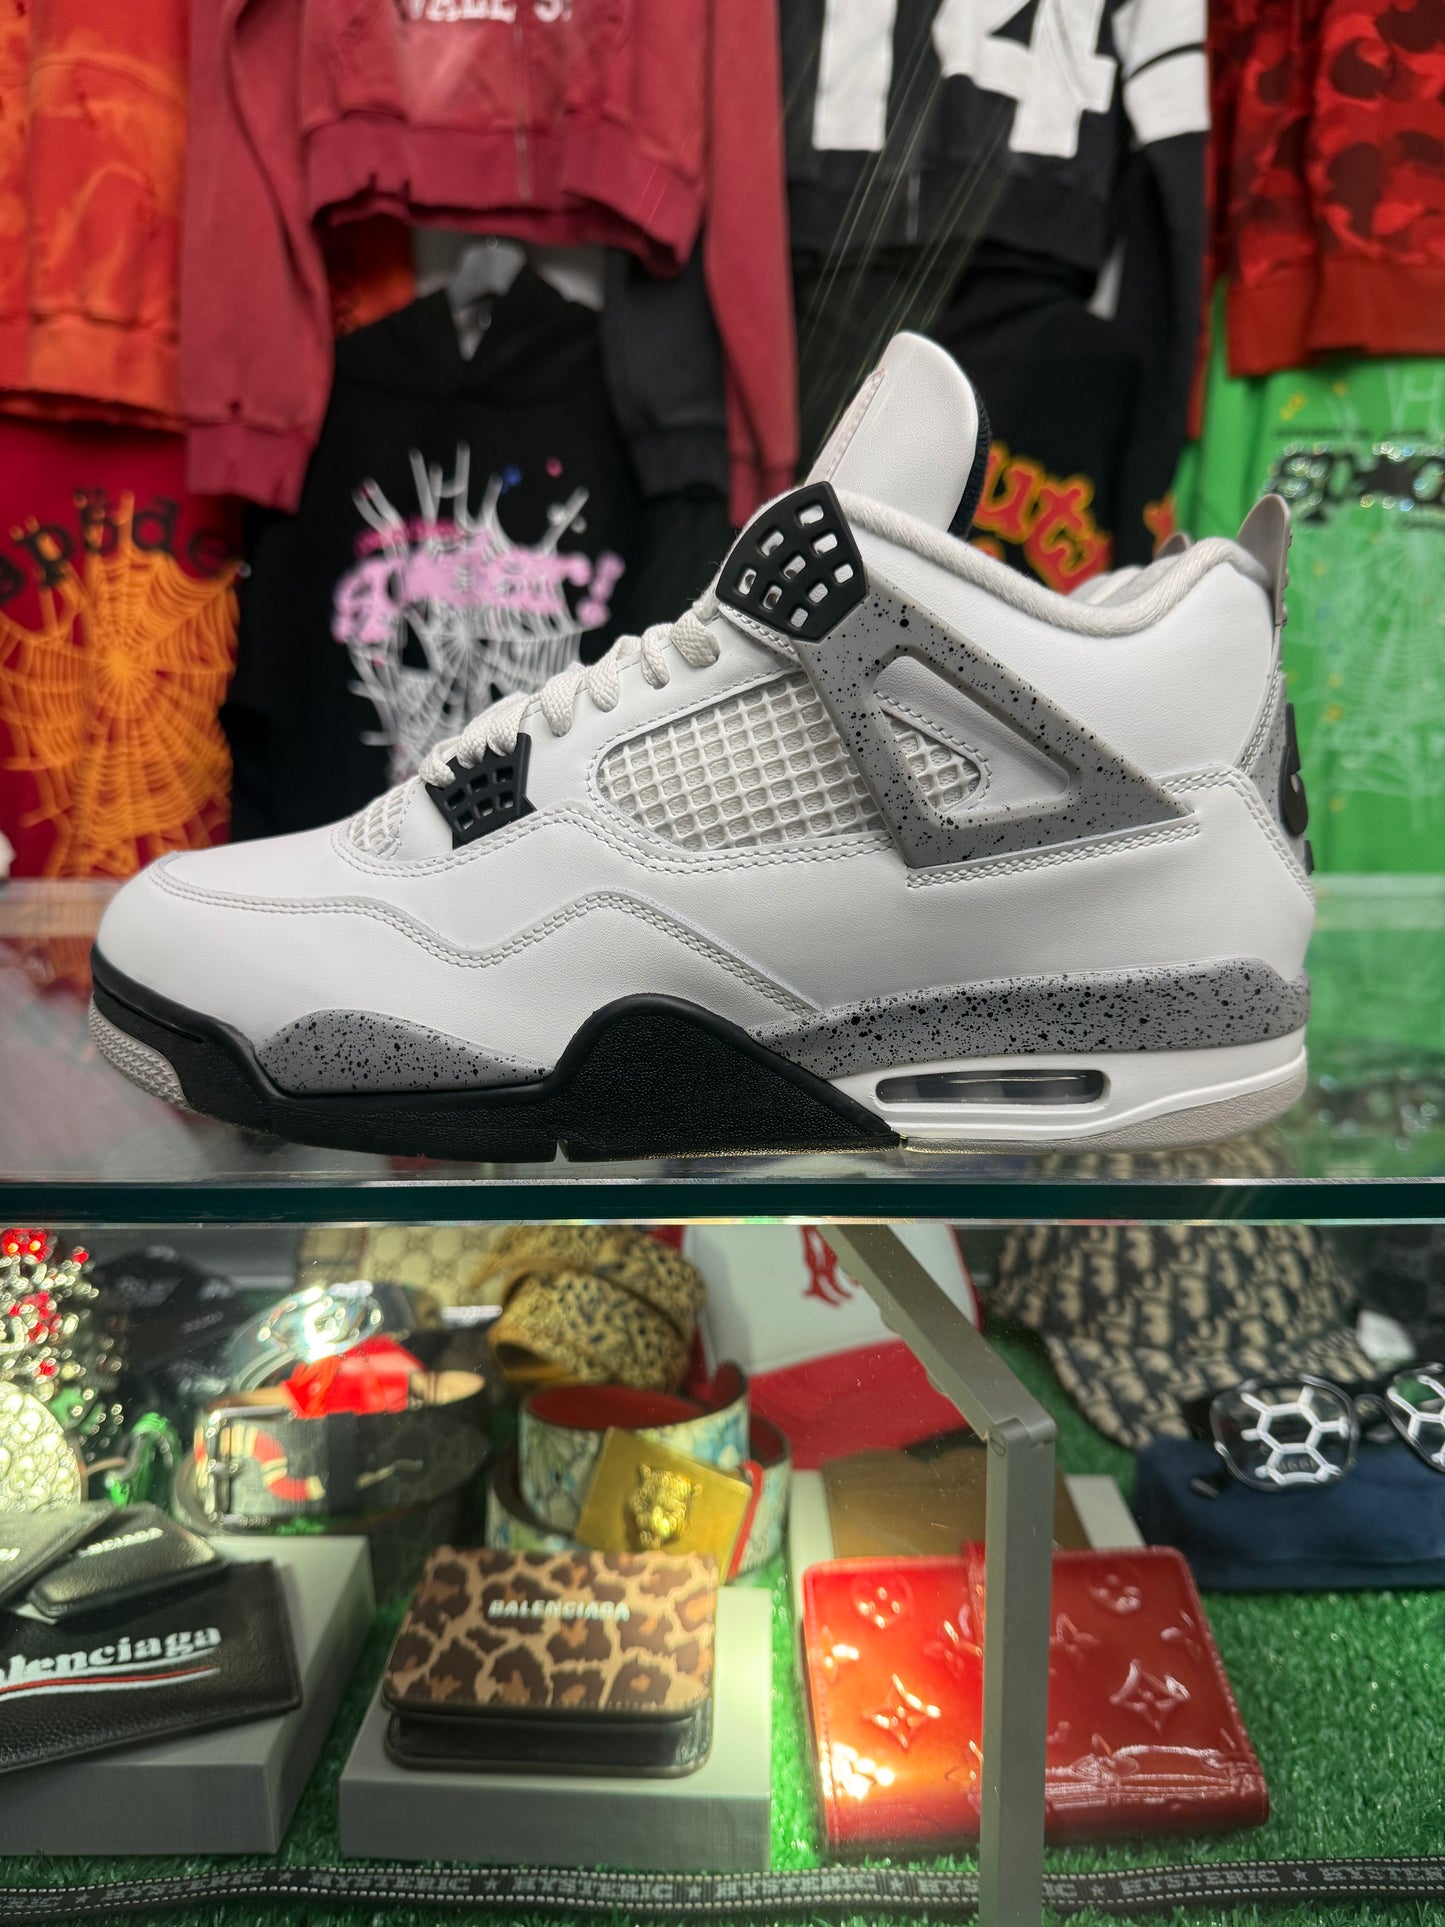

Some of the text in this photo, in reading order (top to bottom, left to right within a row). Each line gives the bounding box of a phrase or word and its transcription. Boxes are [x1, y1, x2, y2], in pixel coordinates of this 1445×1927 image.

[0, 1626, 223, 1684] lenciaga
[309, 1872, 471, 1892] HYSTERIC
[511, 1875, 675, 1900] HYSTERIC
[716, 1874, 877, 1900] HYSTERIC
[1120, 1868, 1281, 1896] HYSTERIC
